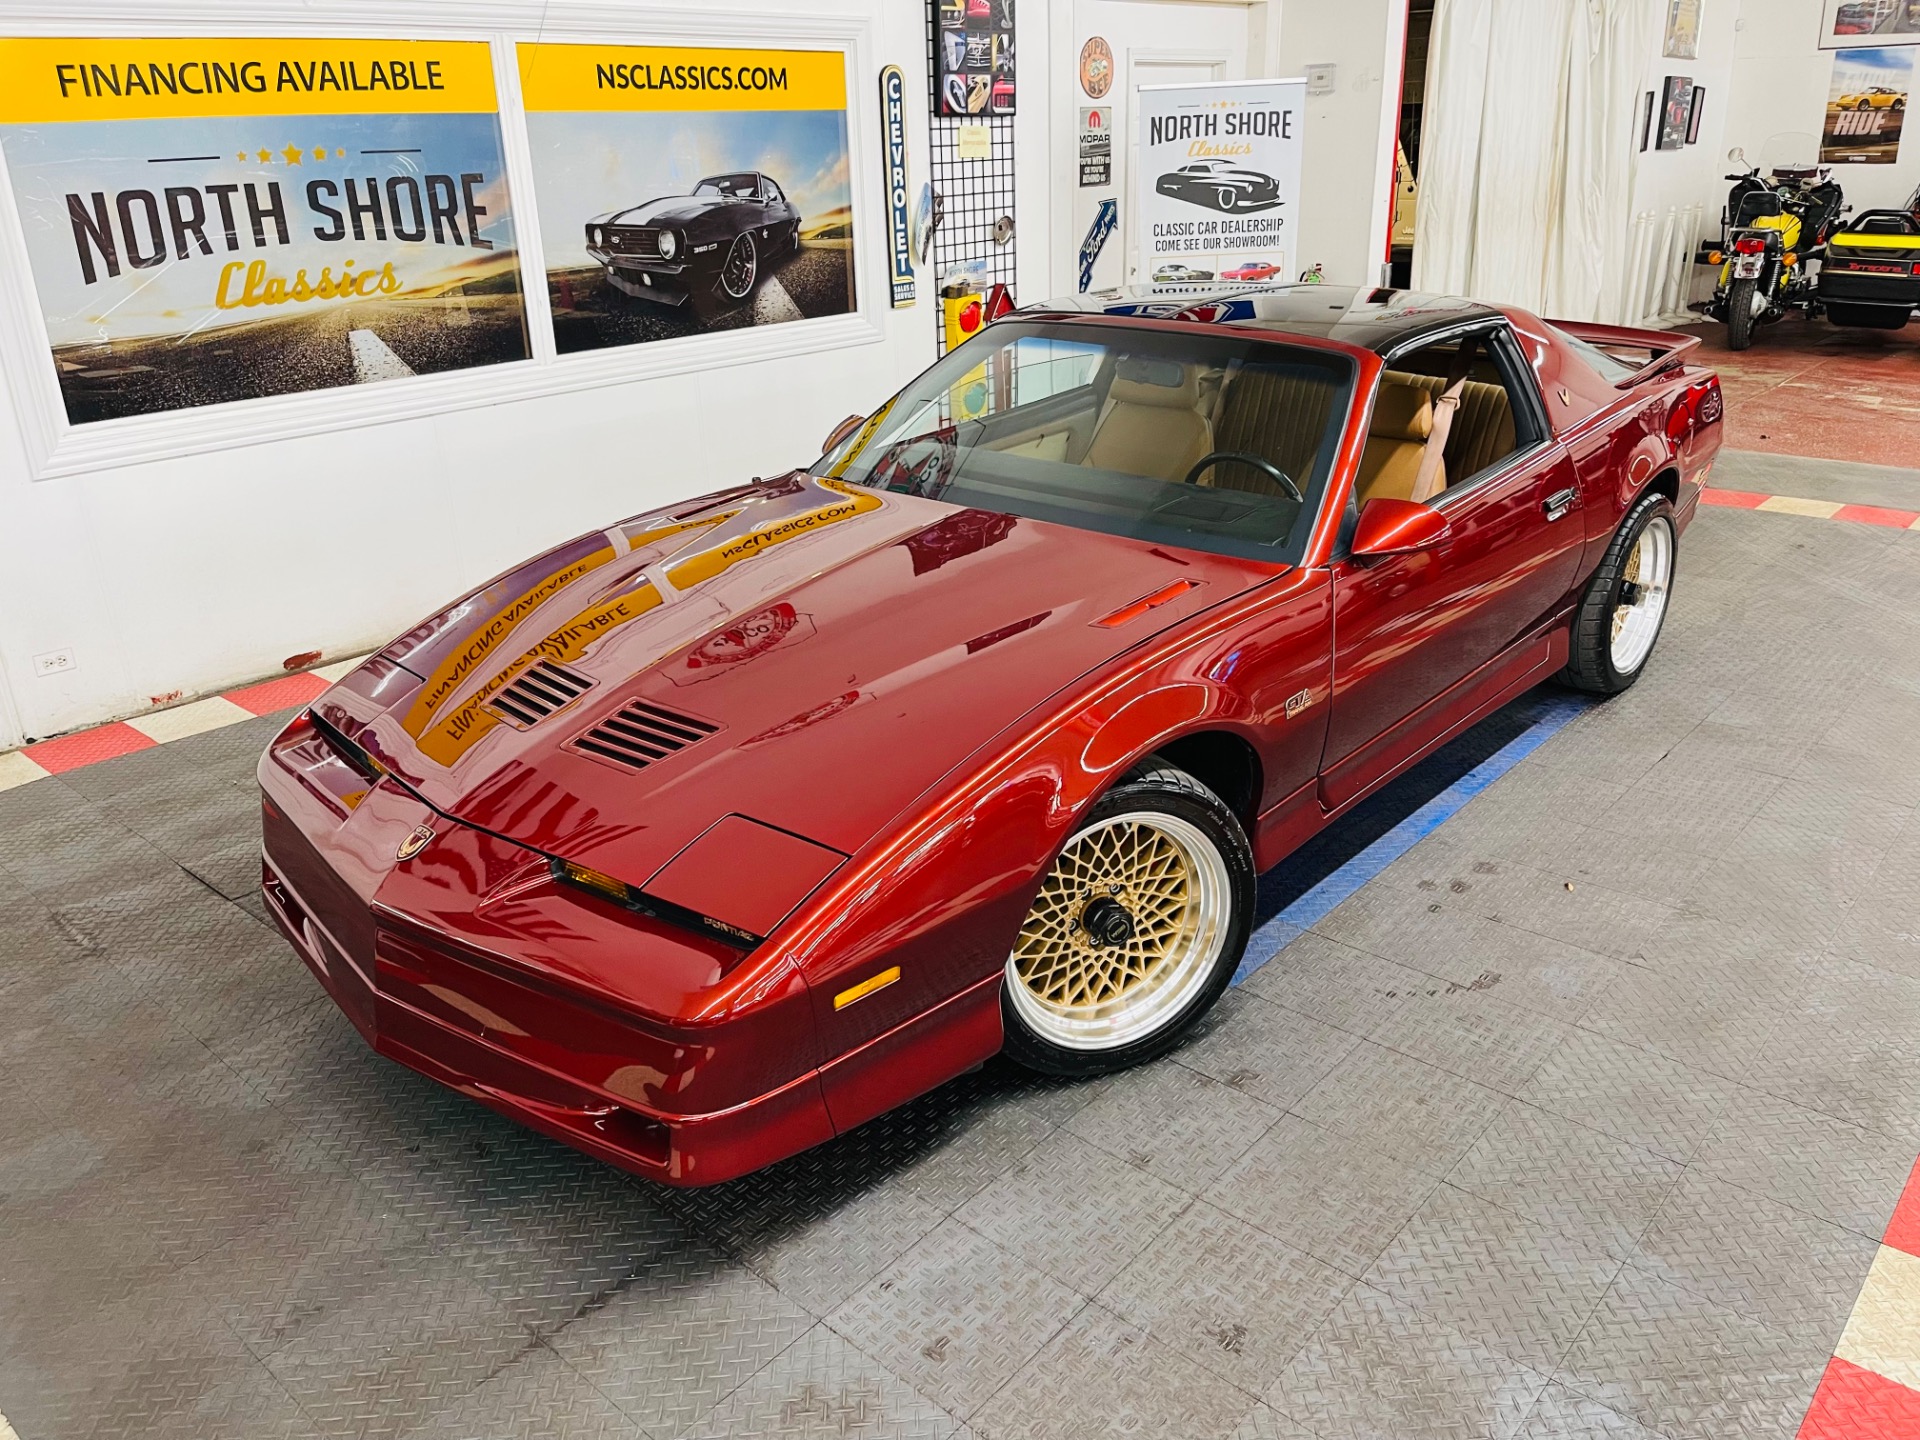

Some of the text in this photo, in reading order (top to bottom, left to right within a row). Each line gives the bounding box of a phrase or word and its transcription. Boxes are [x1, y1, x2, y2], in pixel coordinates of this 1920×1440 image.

[1083, 40, 1110, 60] SUPER
[56, 61, 445, 98] FINANCING AVAILABLE
[596, 63, 788, 91] NSCLASSICS.COM
[1088, 73, 1109, 95] BEE
[1150, 110, 1292, 146] NORTH SHORE
[1833, 111, 1887, 135] RIDE
[1080, 134, 1110, 143] MOPAR
[1187, 140, 1253, 157] Classics
[889, 78, 908, 272] CHEVROLET
[65, 173, 494, 285] NORTH SHORE
[1153, 218, 1284, 237] CLASSIC CAR DEALERSHIP
[1086, 220, 1108, 263] Ford
[1155, 234, 1280, 251] COME SEE OUR SHOWROOM!
[215, 259, 403, 310] Classics
[703, 917, 754, 941] PONTIAC
